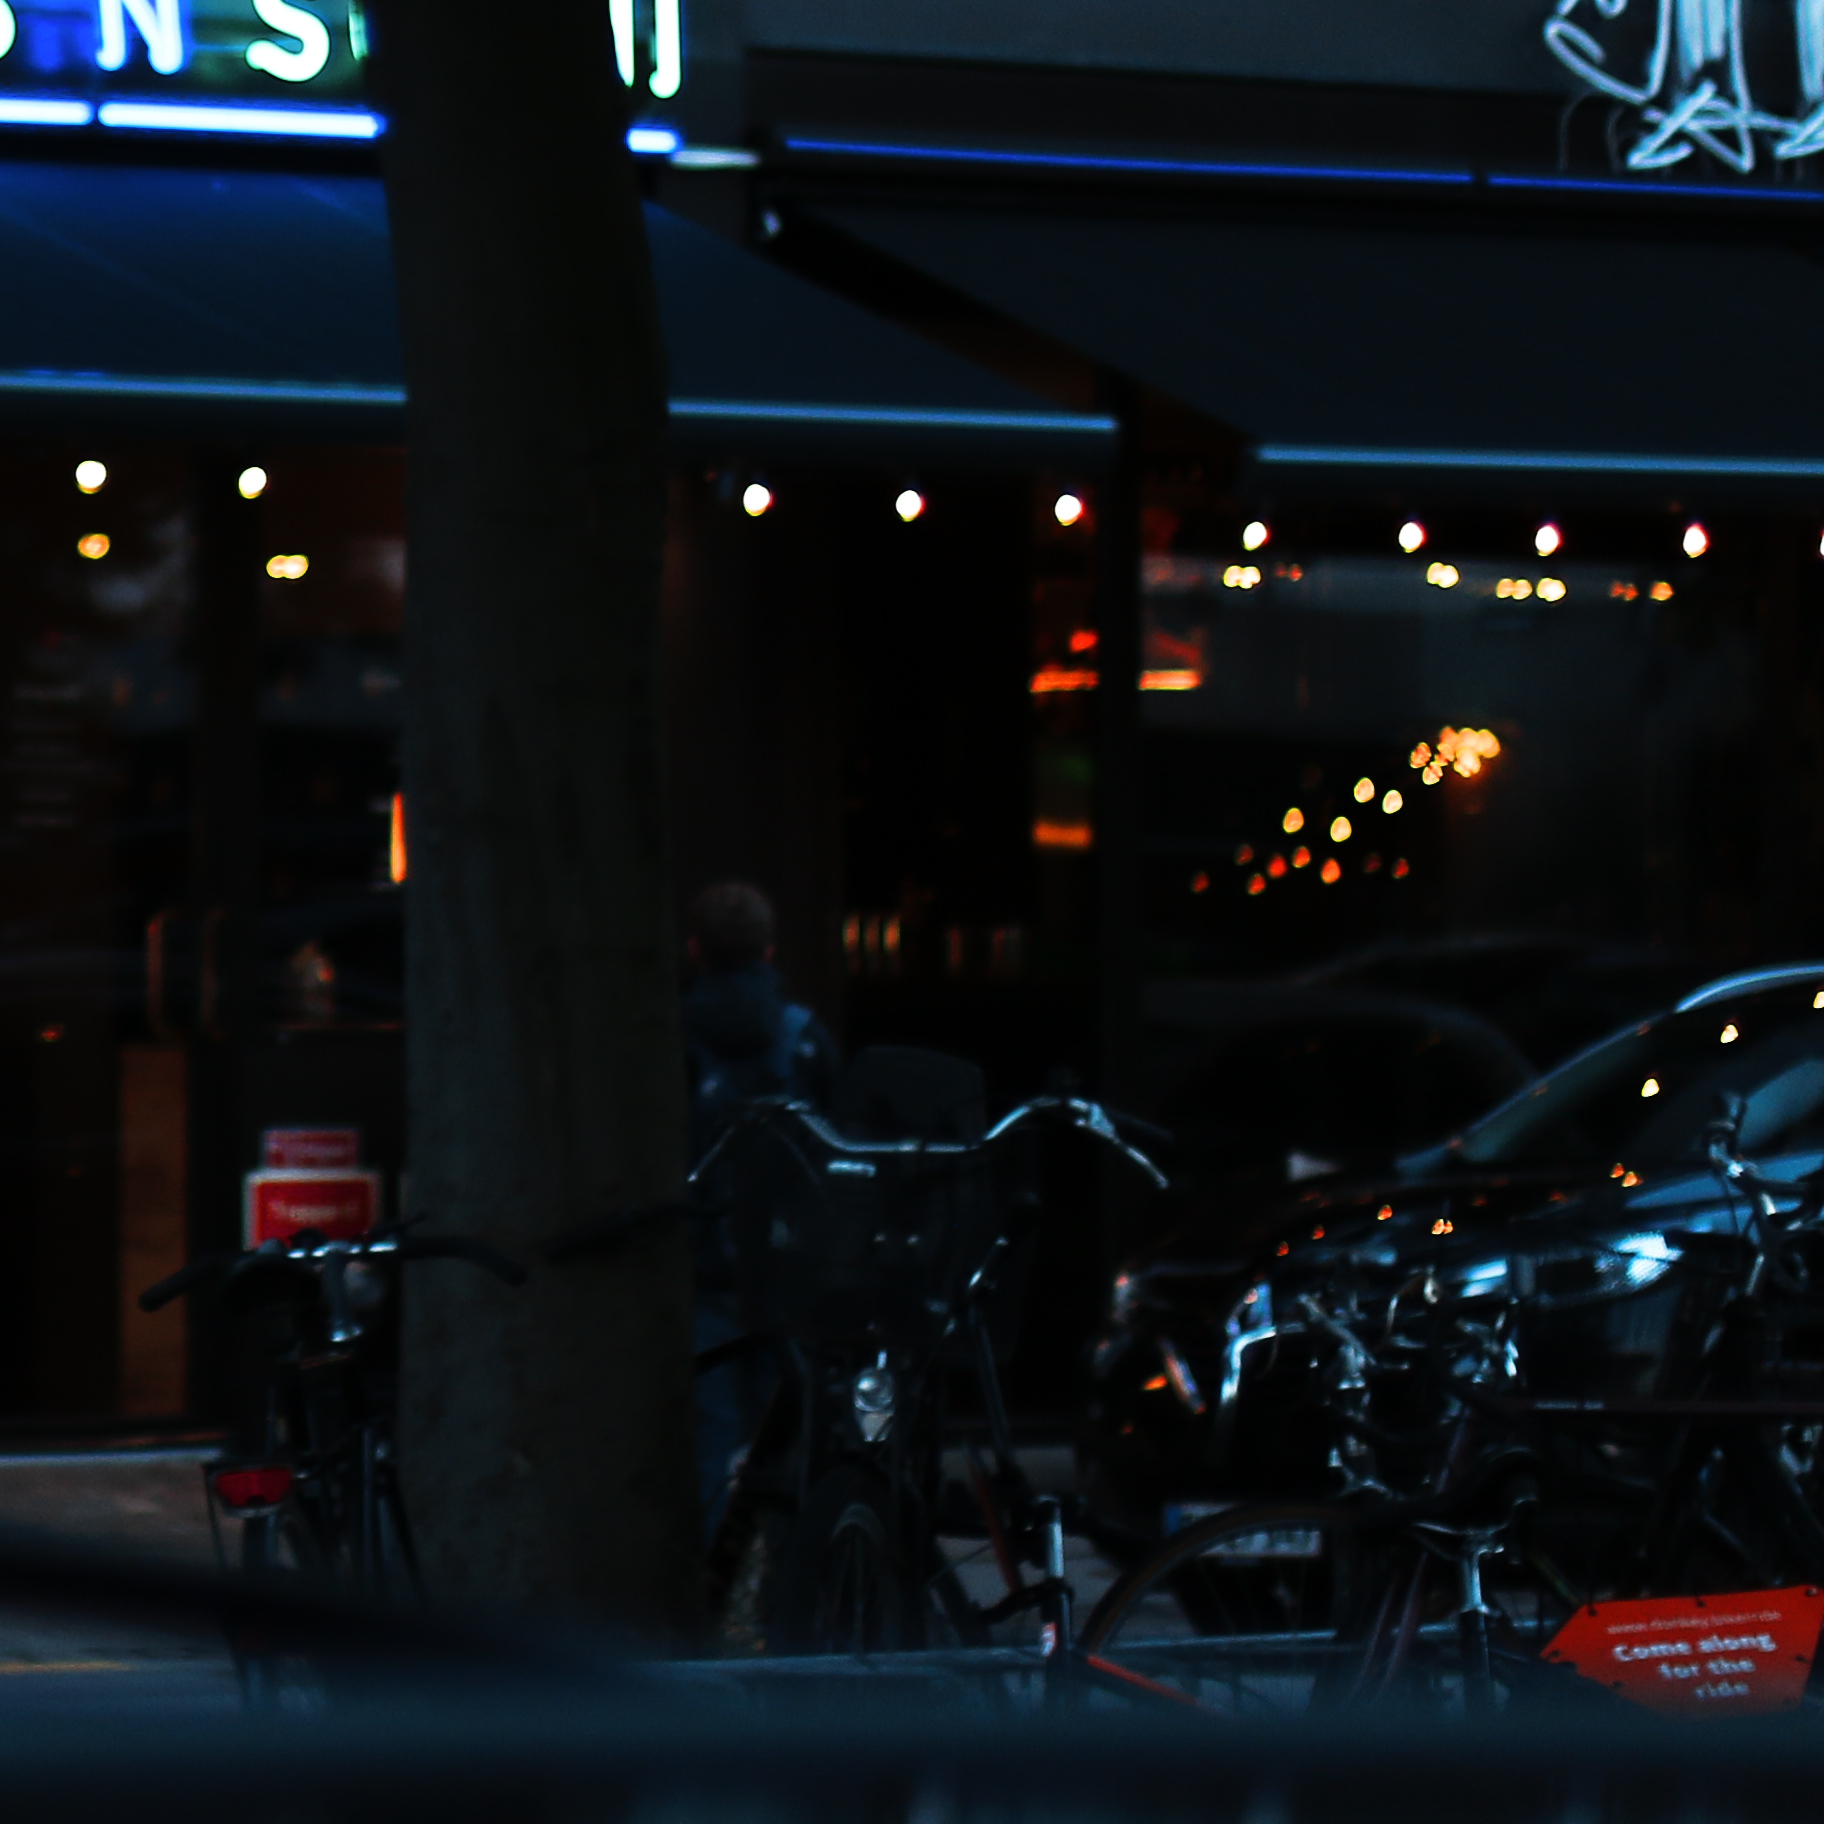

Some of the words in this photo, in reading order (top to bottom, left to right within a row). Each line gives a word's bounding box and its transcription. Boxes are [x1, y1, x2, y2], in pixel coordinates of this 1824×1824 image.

[1612, 1639, 1693, 1663] Come
[1697, 1633, 1777, 1654] along
[1658, 1662, 1701, 1679] for
[1706, 1656, 1756, 1676] the
